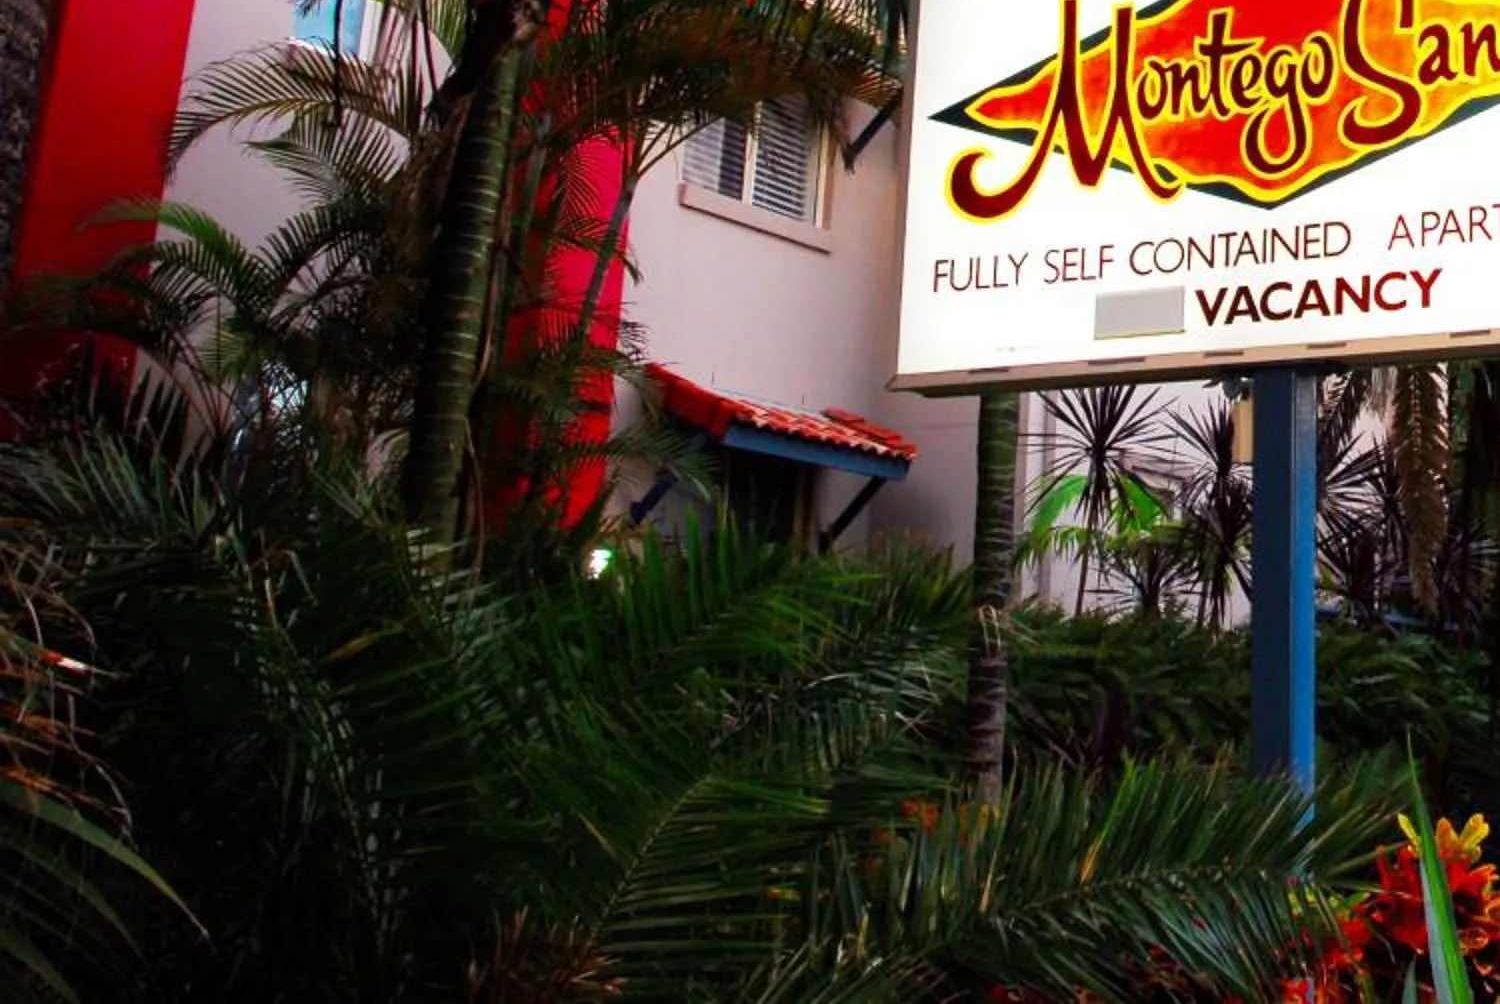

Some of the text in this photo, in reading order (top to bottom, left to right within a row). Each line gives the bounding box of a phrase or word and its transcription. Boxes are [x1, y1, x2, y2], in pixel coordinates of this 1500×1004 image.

[933, 252, 1029, 293] FULLY
[1043, 245, 1115, 284] SELF
[1129, 222, 1351, 277] CONTAINED
[1195, 268, 1443, 327] VACANCY
